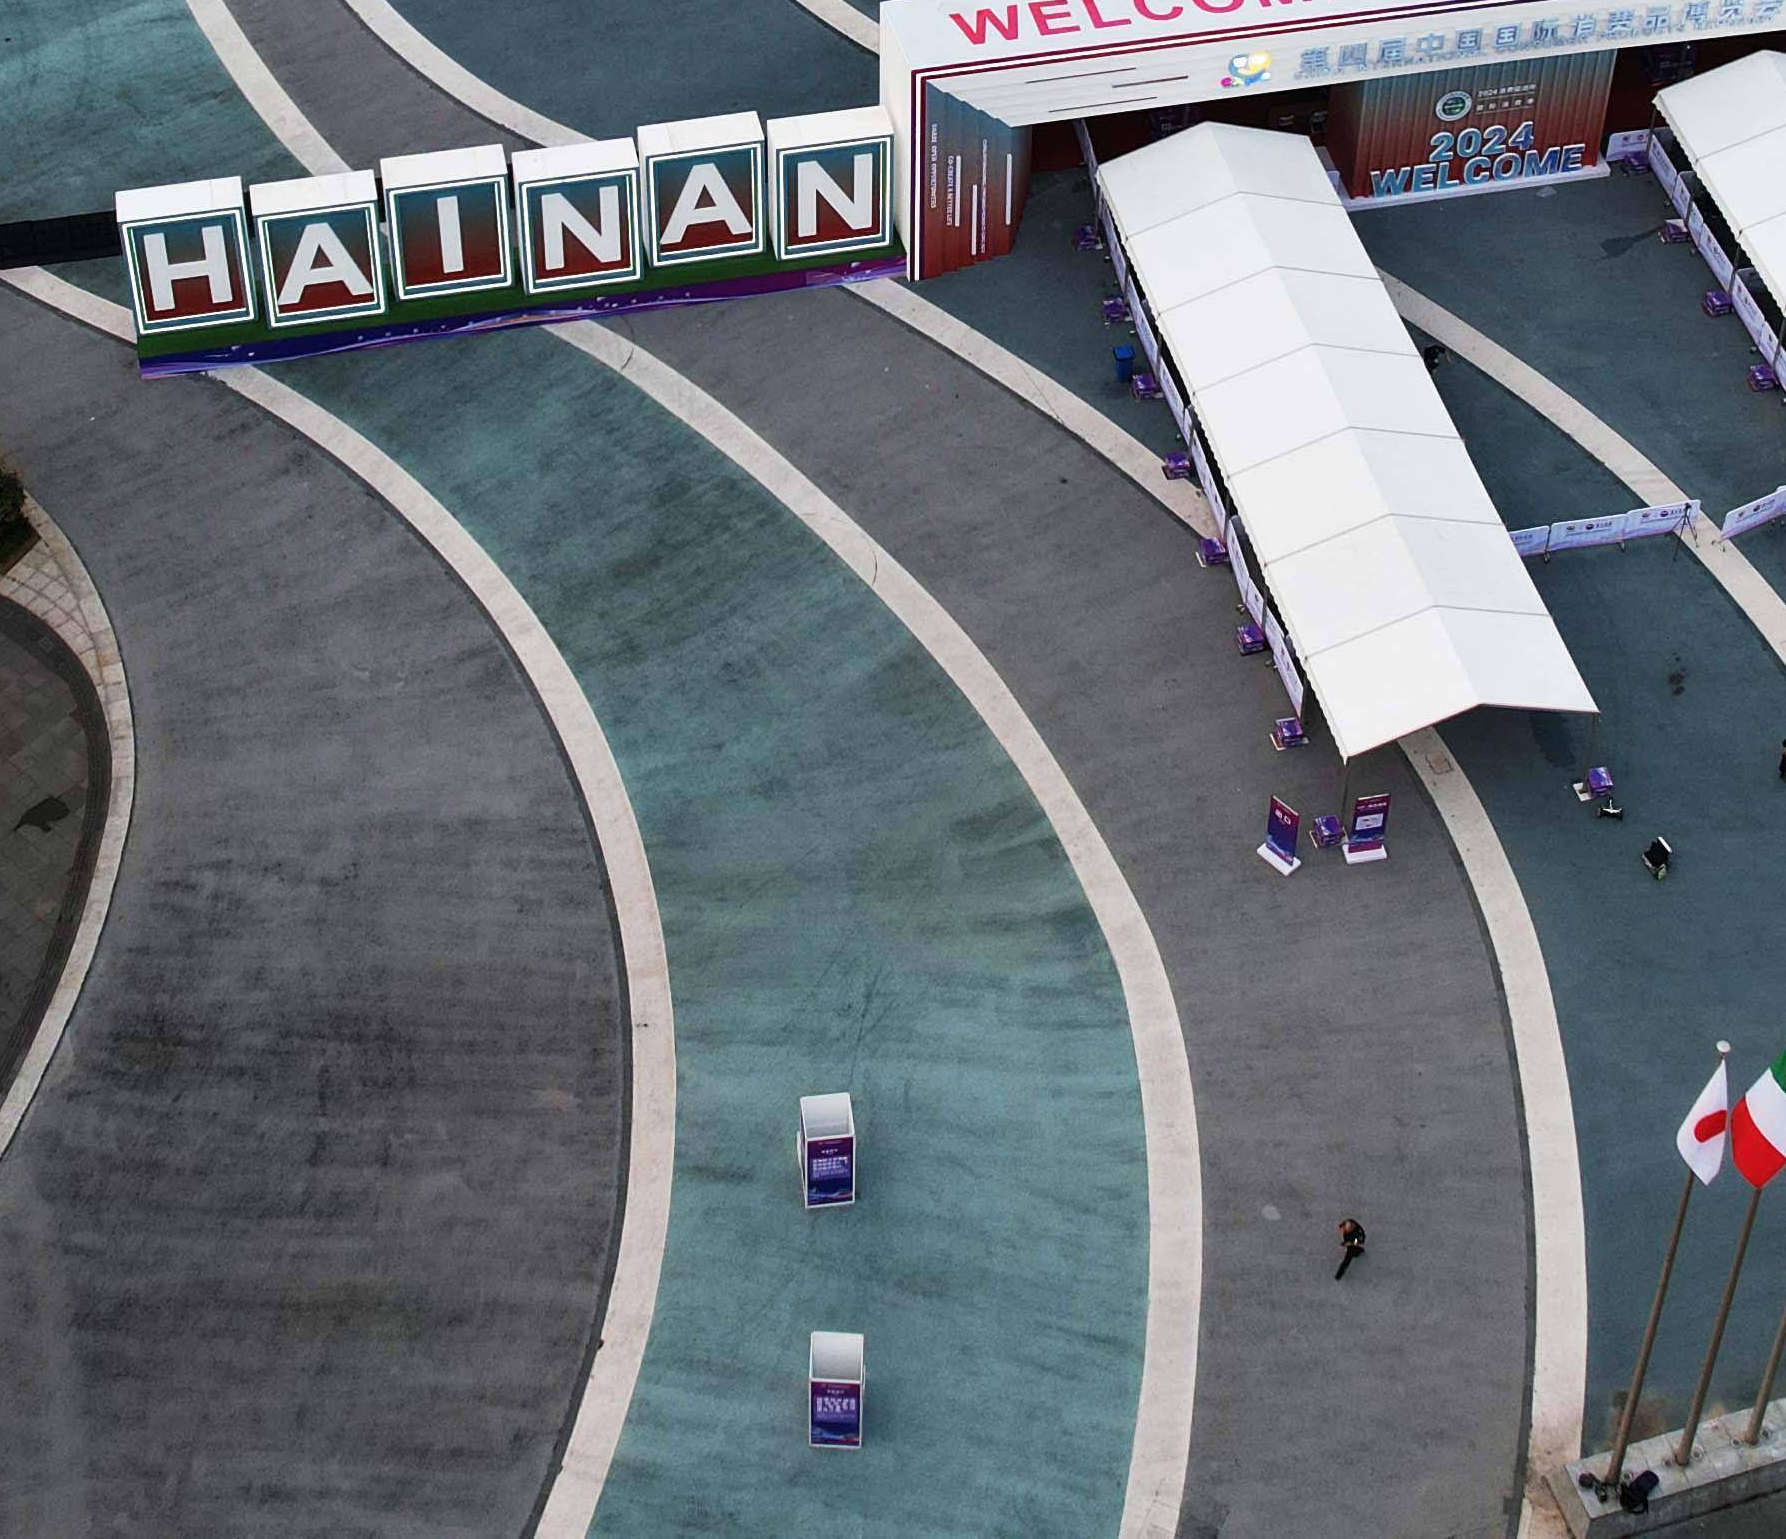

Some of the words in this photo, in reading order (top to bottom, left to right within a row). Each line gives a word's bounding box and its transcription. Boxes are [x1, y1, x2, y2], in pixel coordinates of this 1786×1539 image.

[1428, 120, 1535, 162] 2024
[1370, 143, 1586, 199] WELCOME
[153, 152, 876, 311] HAINAN
